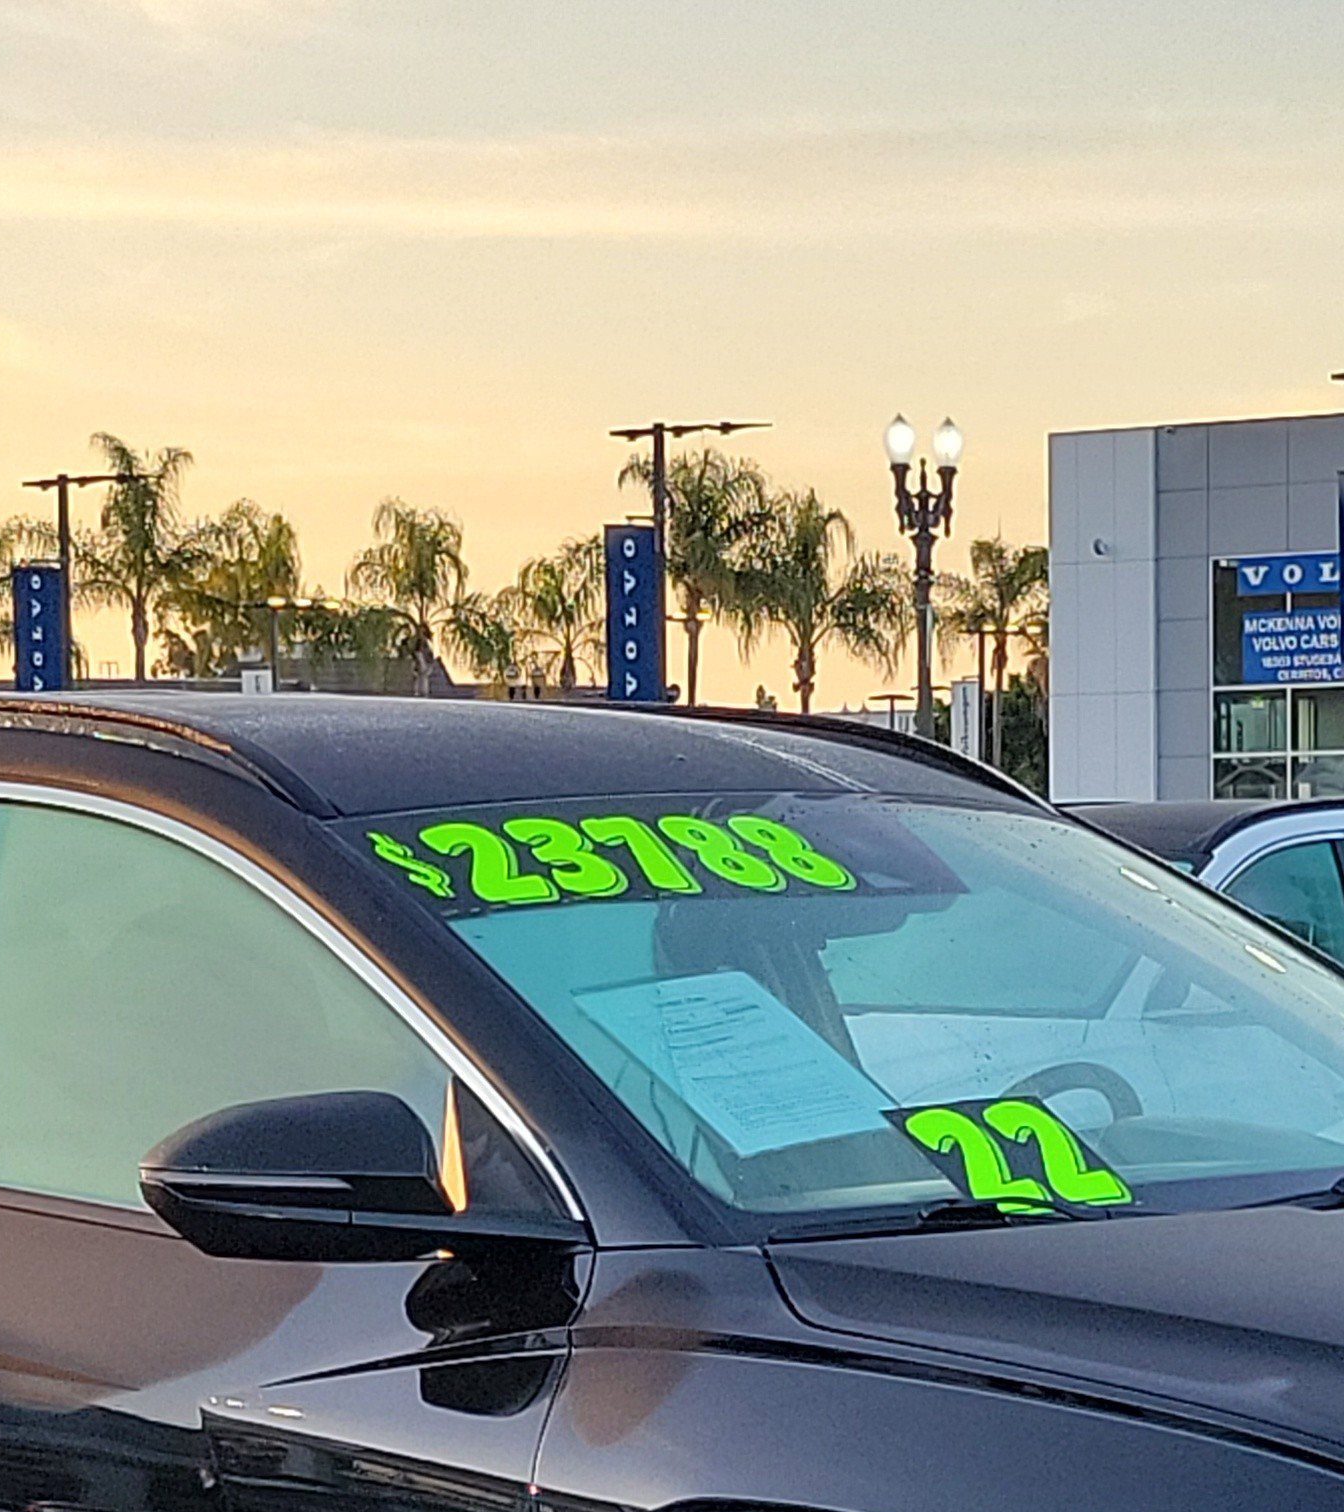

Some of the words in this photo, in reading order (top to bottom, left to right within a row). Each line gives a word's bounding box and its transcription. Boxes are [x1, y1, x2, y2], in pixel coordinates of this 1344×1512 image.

[30, 573, 44, 691] VOLVO
[623, 538, 638, 697] VOLVO
[1244, 616, 1316, 634] MCKENNA
[1252, 635, 1297, 652] VOLVO
[1300, 633, 1338, 650] CARS
[367, 816, 857, 904] $23788
[906, 1101, 1132, 1215] 22
